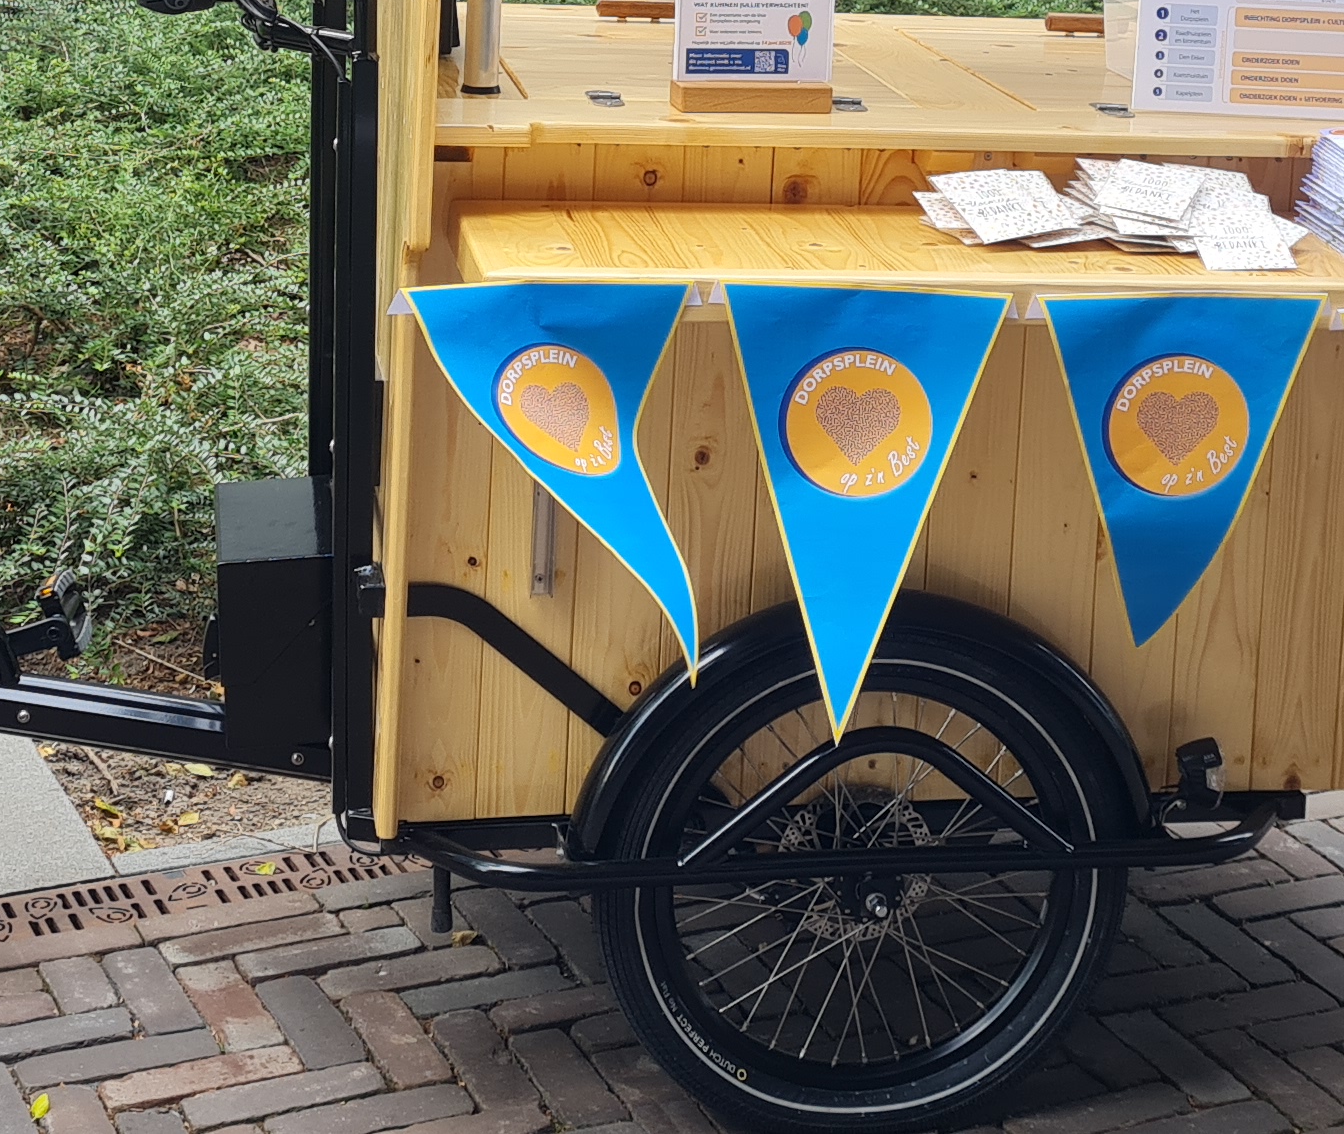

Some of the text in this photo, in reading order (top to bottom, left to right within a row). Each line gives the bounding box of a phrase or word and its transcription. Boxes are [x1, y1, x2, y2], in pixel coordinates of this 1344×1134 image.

[499, 348, 579, 406] DORPSPLEIN
[794, 352, 897, 406] DORPSPLEIN
[1116, 359, 1214, 412] DORPSPLEIN
[594, 426, 613, 460] Best
[840, 472, 858, 494] op
[888, 436, 921, 478] Best
[1161, 472, 1178, 494] op
[1206, 435, 1238, 474] Best
[676, 1014, 709, 1053] PERFECT
[709, 1049, 736, 1073] DUTCH
